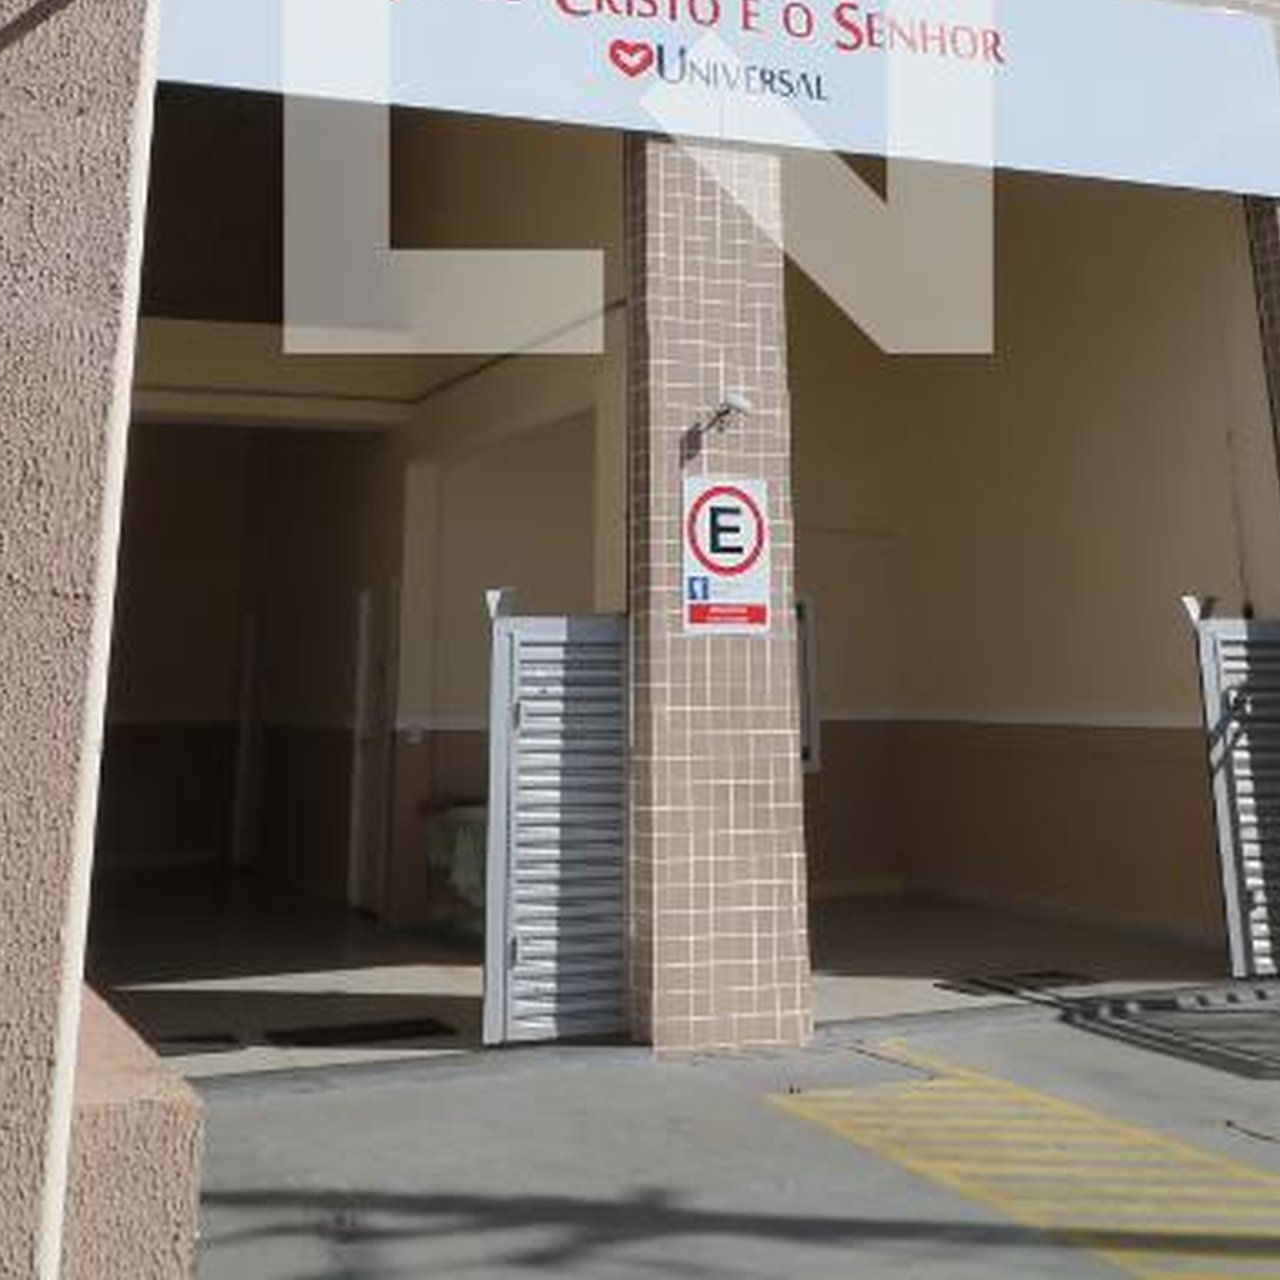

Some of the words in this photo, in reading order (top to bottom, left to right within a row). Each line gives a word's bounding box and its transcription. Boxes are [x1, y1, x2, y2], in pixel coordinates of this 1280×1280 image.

[834, 2, 1007, 65] SENHOR
[656, 44, 830, 102] UNIVERSAL
[709, 506, 744, 554] E
